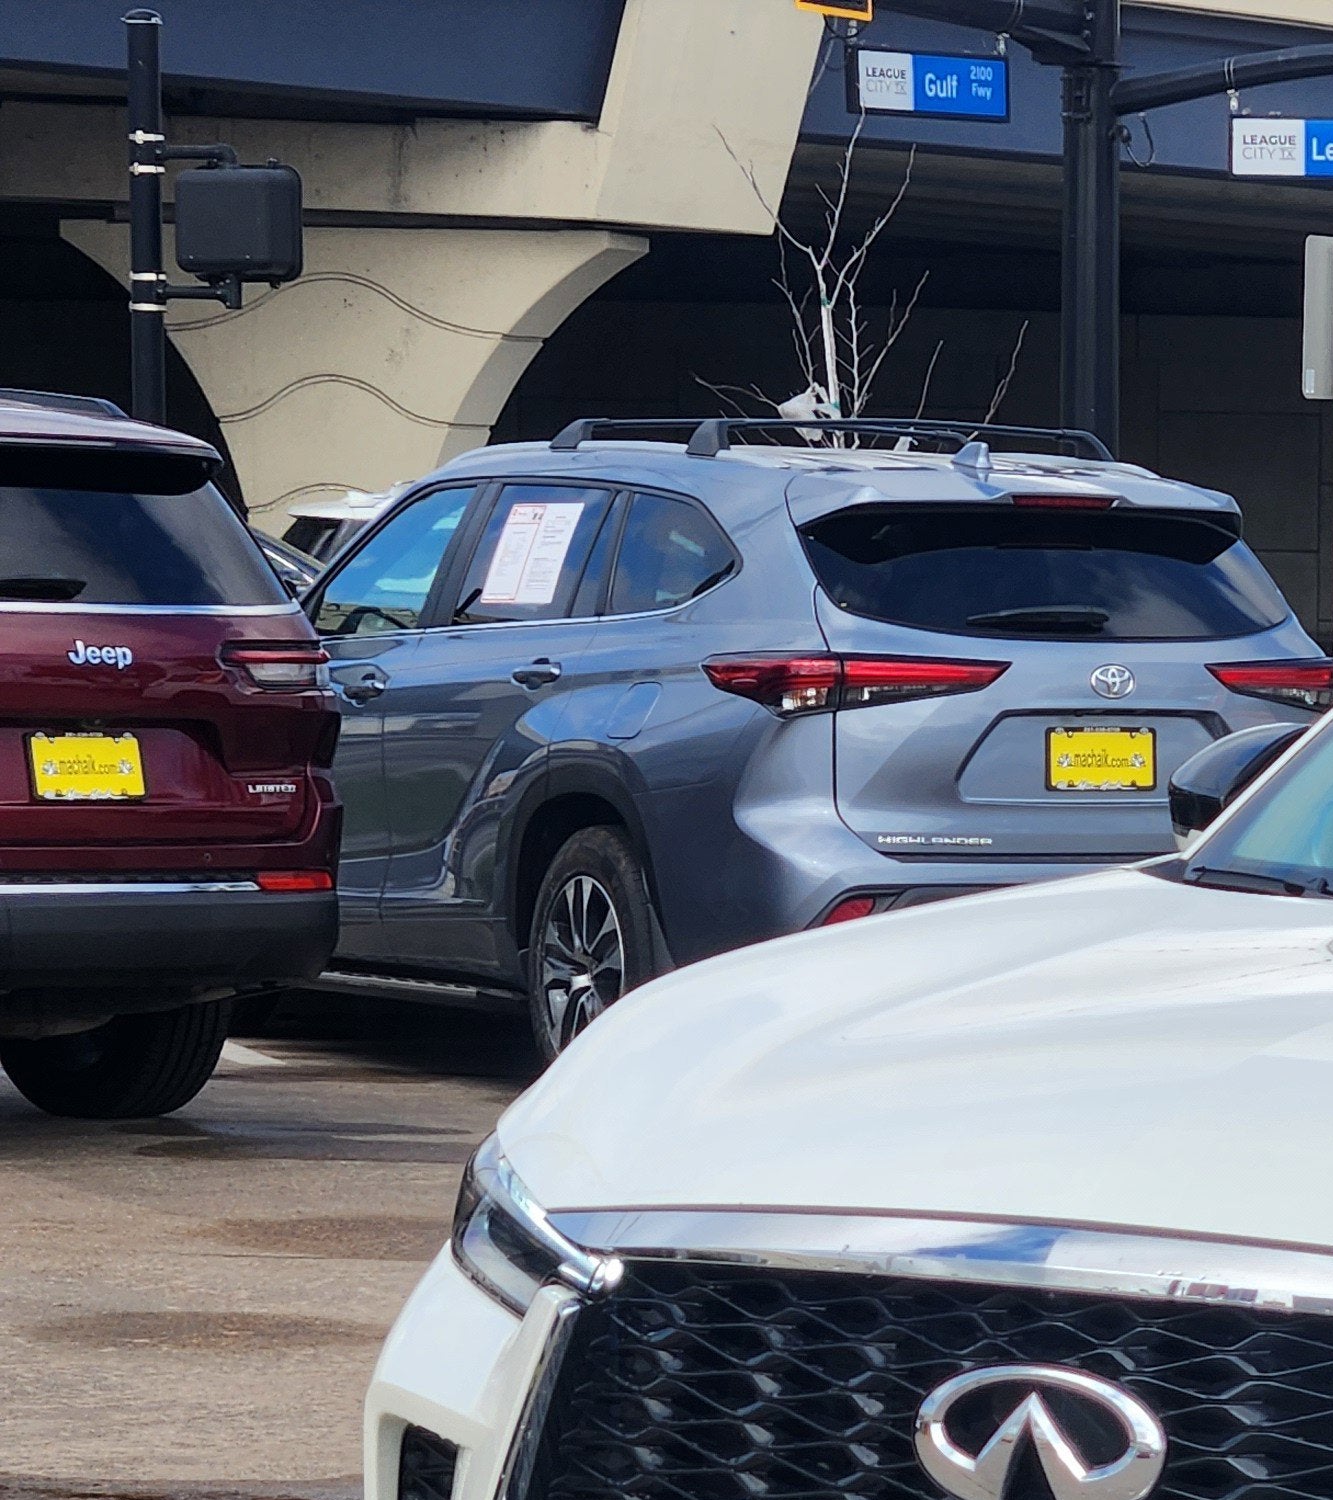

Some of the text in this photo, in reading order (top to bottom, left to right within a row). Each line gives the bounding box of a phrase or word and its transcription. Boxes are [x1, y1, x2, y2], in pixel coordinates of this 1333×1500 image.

[866, 67, 906, 79] LEAGUE
[970, 66, 993, 81] 2100
[866, 80, 890, 93] CITY
[925, 73, 958, 98] Gulf
[971, 83, 992, 100] Fwy
[1242, 134, 1296, 146] LEAGUE
[1242, 147, 1296, 161] CITY TX
[68, 640, 133, 669] Jeep
[877, 835, 993, 845] HIGHLANDER
